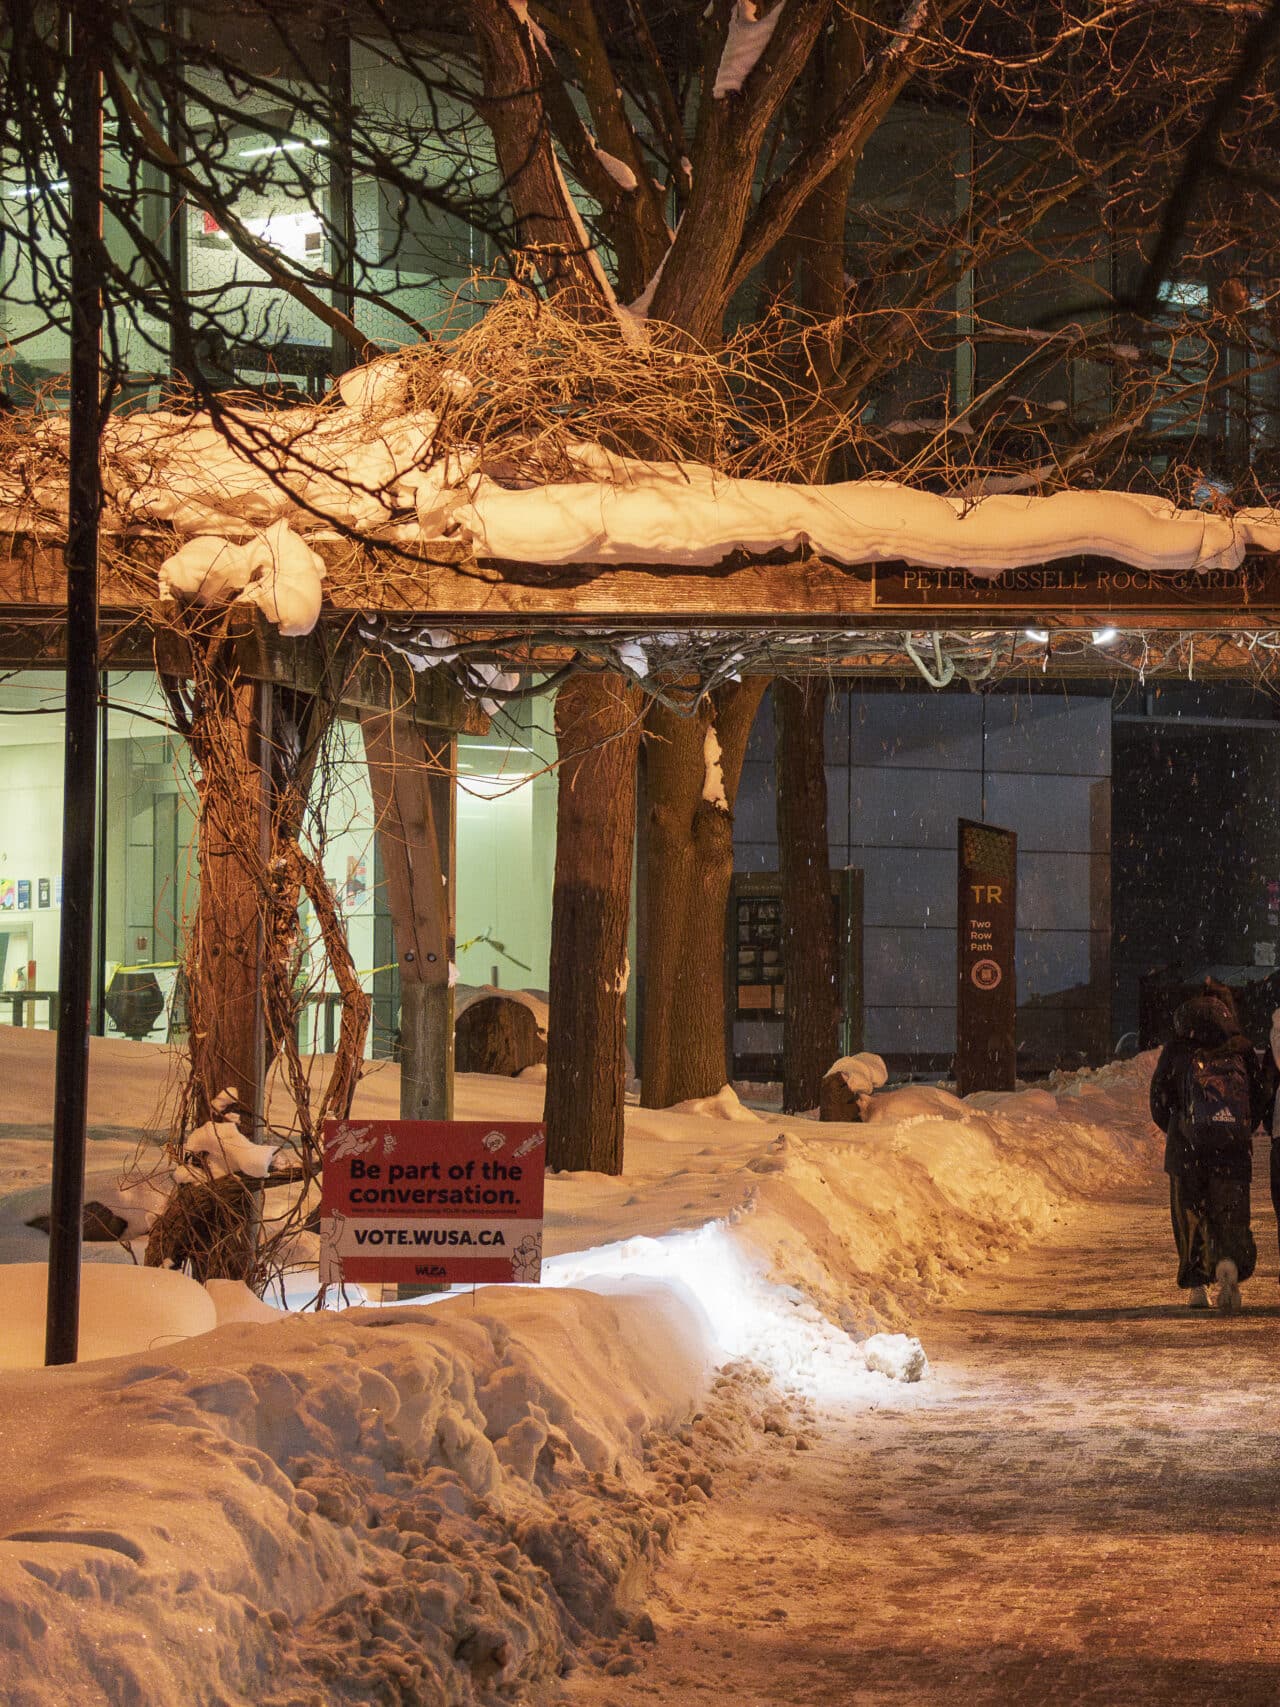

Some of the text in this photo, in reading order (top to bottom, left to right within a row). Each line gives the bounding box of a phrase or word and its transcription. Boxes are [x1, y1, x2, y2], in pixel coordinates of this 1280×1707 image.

[903, 570, 975, 589] PETER
[1097, 570, 1163, 589] ROCK
[970, 885, 1002, 904] TR
[970, 919, 991, 928] Two
[970, 931, 992, 940] Row
[970, 942, 993, 951] Path
[350, 1159, 522, 1184] Be part of the
[349, 1184, 521, 1205] conversation.
[354, 1229, 505, 1246] VOTE.WUSA.CA
